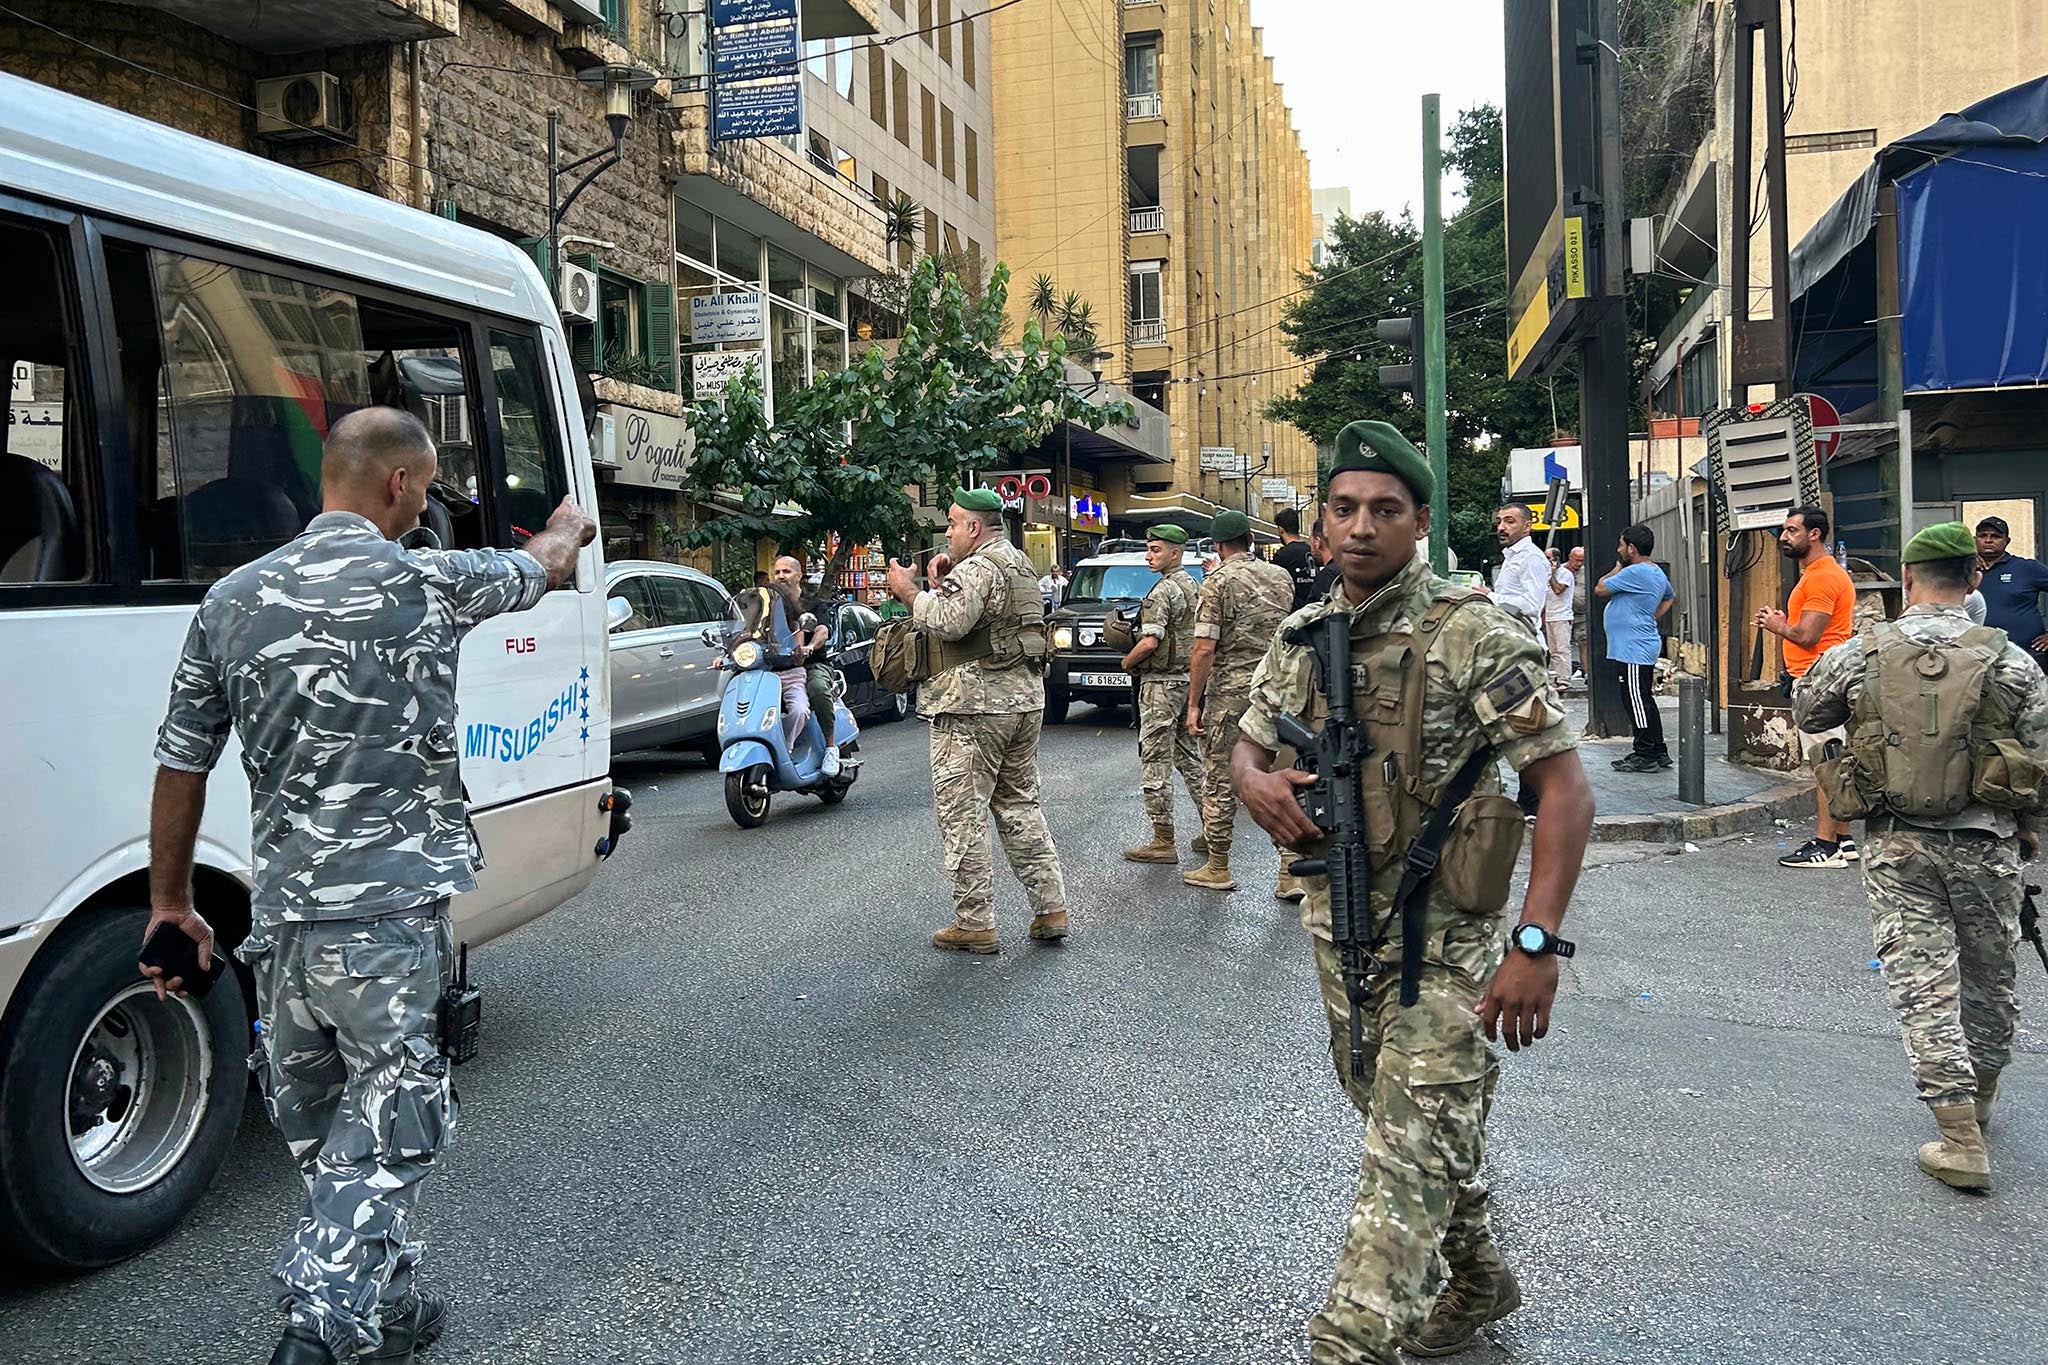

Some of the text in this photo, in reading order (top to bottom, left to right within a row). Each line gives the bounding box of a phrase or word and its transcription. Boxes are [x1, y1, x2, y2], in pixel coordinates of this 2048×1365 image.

[729, 32, 749, 40] Rima
[760, 26, 794, 35] Abdallah
[738, 87, 760, 96] Jihad
[762, 84, 797, 93] Abdallah
[1570, 231, 1579, 283] PIKASSO 021
[694, 293, 759, 308] Dr. Ali Khalil
[696, 381, 705, 391] Dr
[505, 637, 536, 655] FUS
[1087, 676, 1094, 684] G
[1097, 676, 1127, 685] 618254
[465, 682, 578, 763] MITSUBISHI
